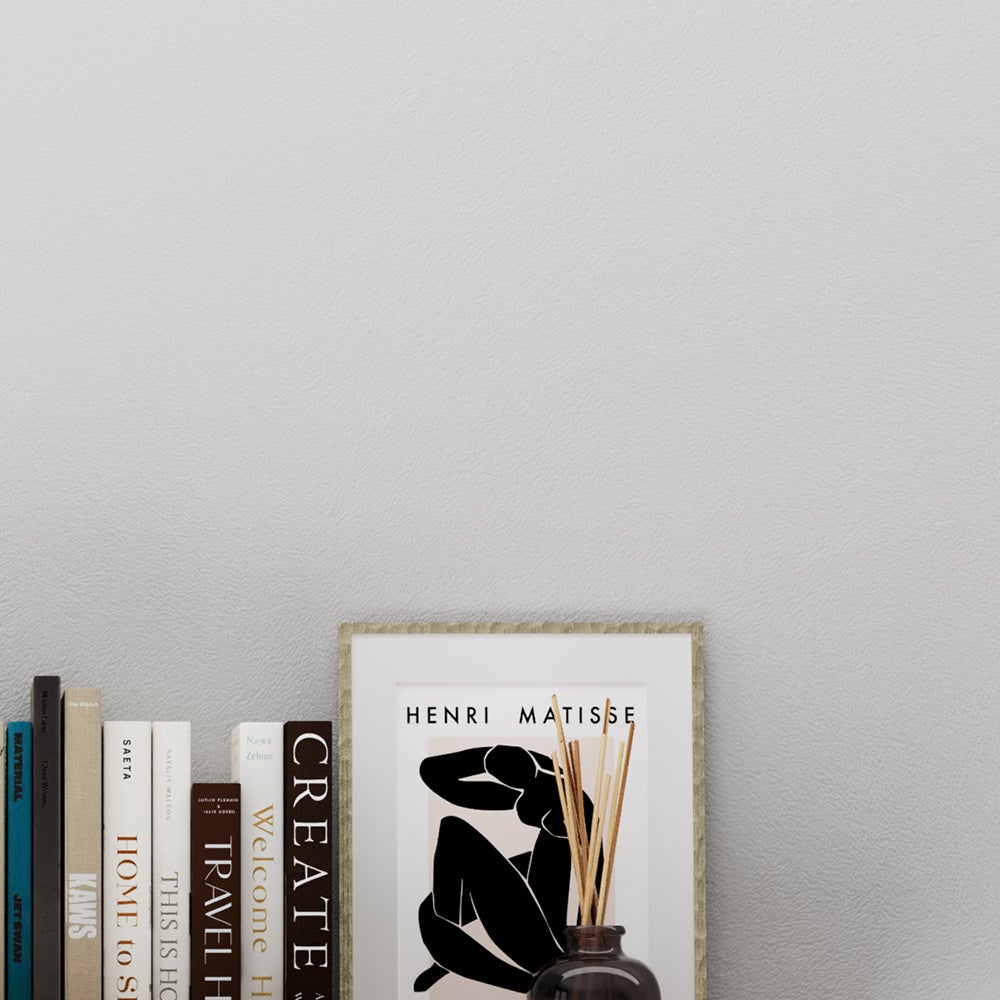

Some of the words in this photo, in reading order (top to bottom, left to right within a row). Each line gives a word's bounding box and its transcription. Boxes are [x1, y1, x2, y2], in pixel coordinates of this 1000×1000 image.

[407, 706, 488, 724] HENRI
[519, 706, 634, 724] MATISSE
[123, 740, 131, 779] SAETA
[247, 735, 271, 747] Najwa
[12, 731, 23, 802] MATERIAL
[293, 733, 329, 969] CREATE
[117, 837, 137, 927] HOME
[160, 872, 178, 930] THIS
[204, 835, 233, 964] TRAVEL
[252, 805, 274, 952] Welcome
[13, 894, 22, 919] JET
[66, 873, 98, 942] KAWS
[13, 921, 22, 963] SWAN
[117, 941, 134, 966] to
[160, 940, 177, 958] IS
